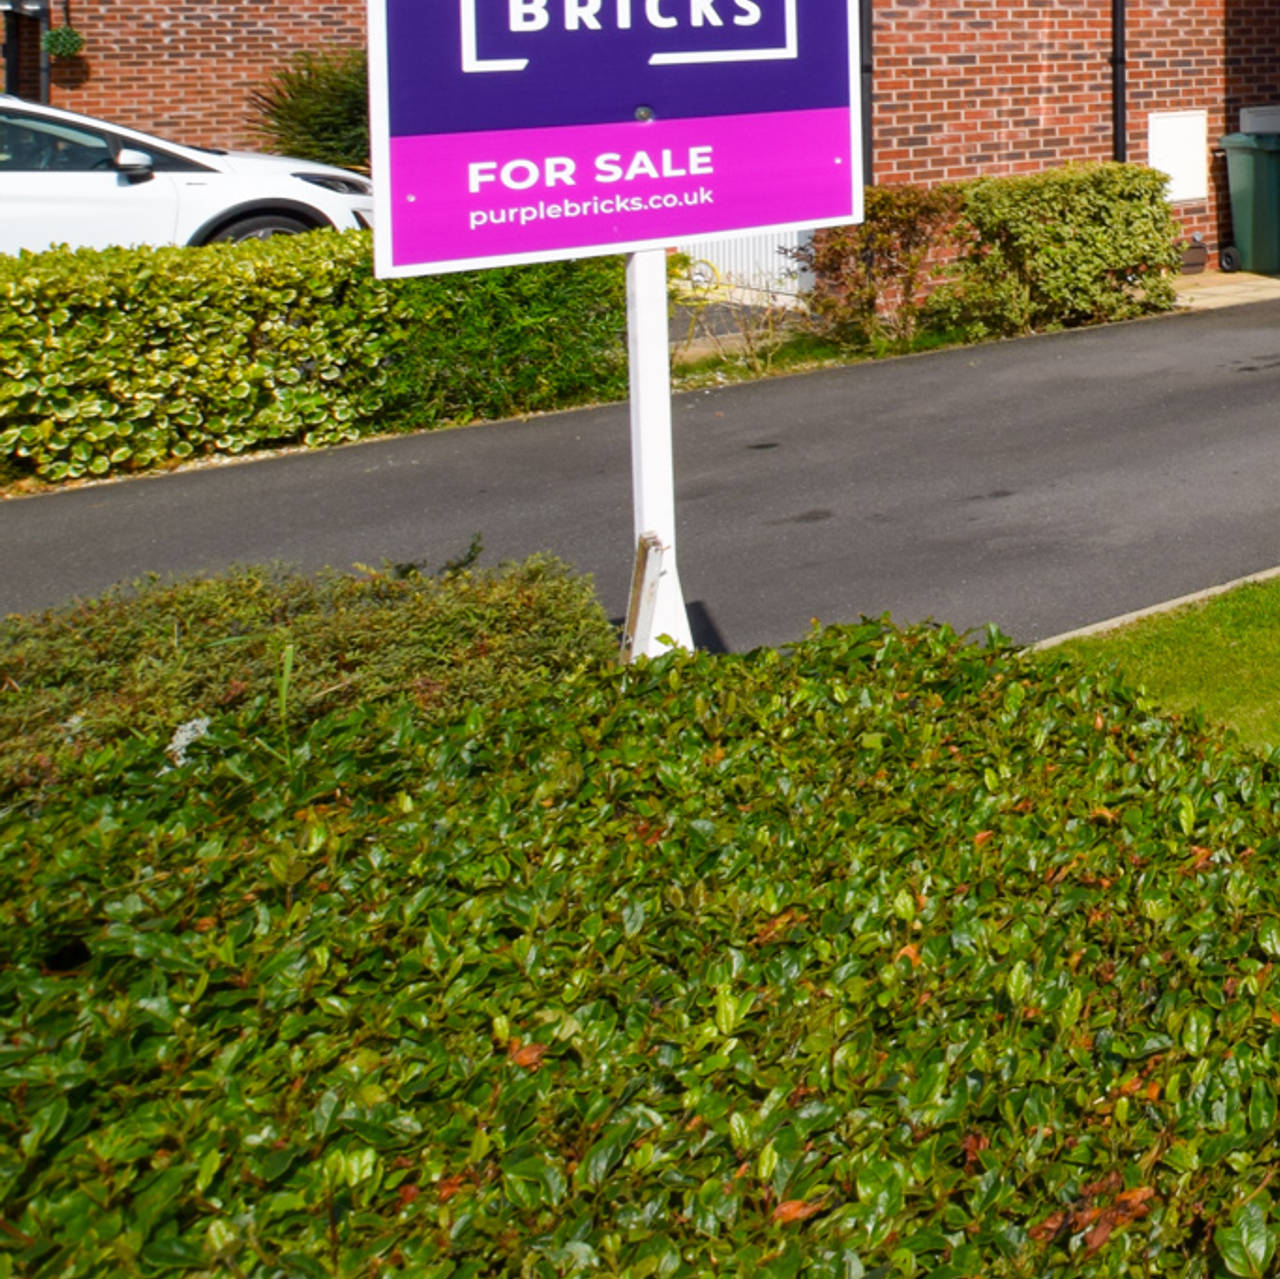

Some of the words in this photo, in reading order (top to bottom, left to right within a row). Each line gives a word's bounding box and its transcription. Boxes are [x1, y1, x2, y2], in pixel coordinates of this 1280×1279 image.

[469, 158, 577, 193] FOR
[594, 146, 714, 182] SALE
[469, 187, 714, 229] purplebricks.co.uk
